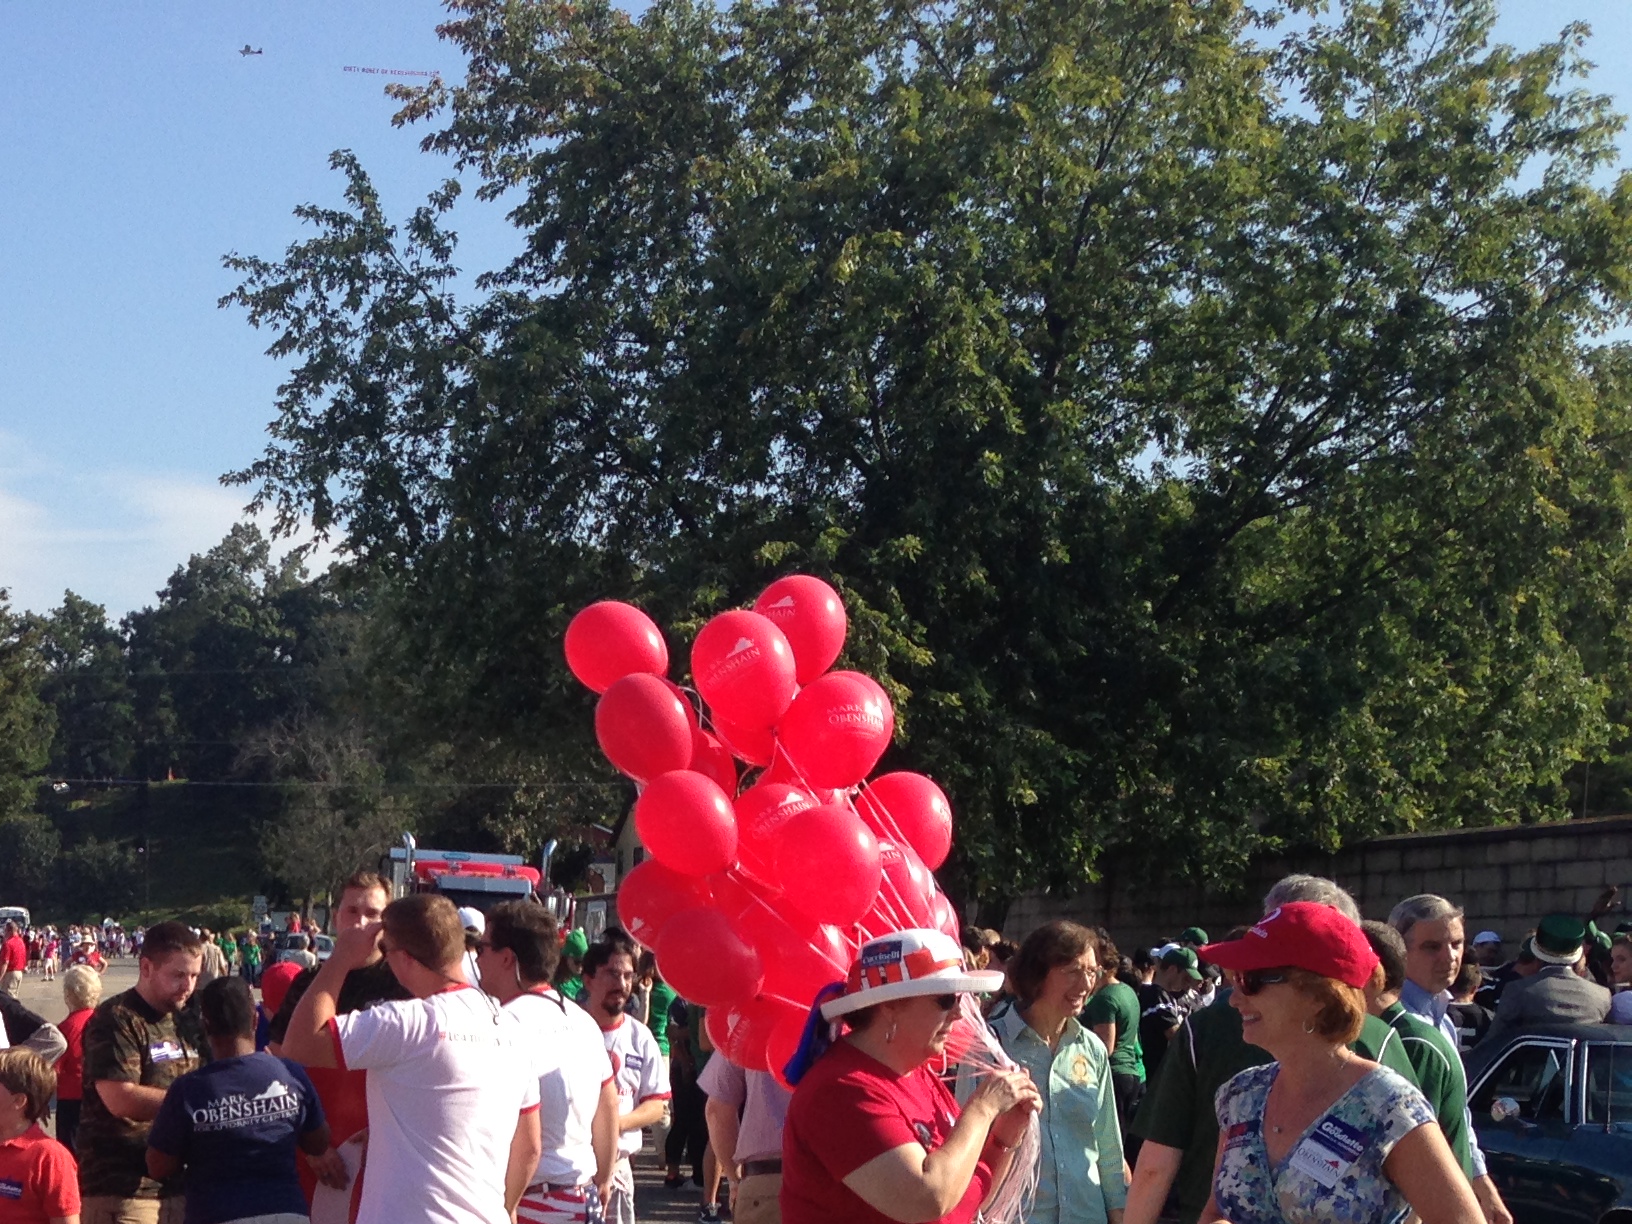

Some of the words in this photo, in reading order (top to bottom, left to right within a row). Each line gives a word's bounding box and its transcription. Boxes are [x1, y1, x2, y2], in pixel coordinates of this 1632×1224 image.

[192, 1093, 299, 1124] OBENSHAIN
[207, 1093, 248, 1109] MARK
[1321, 1120, 1364, 1153] Goodlatte
